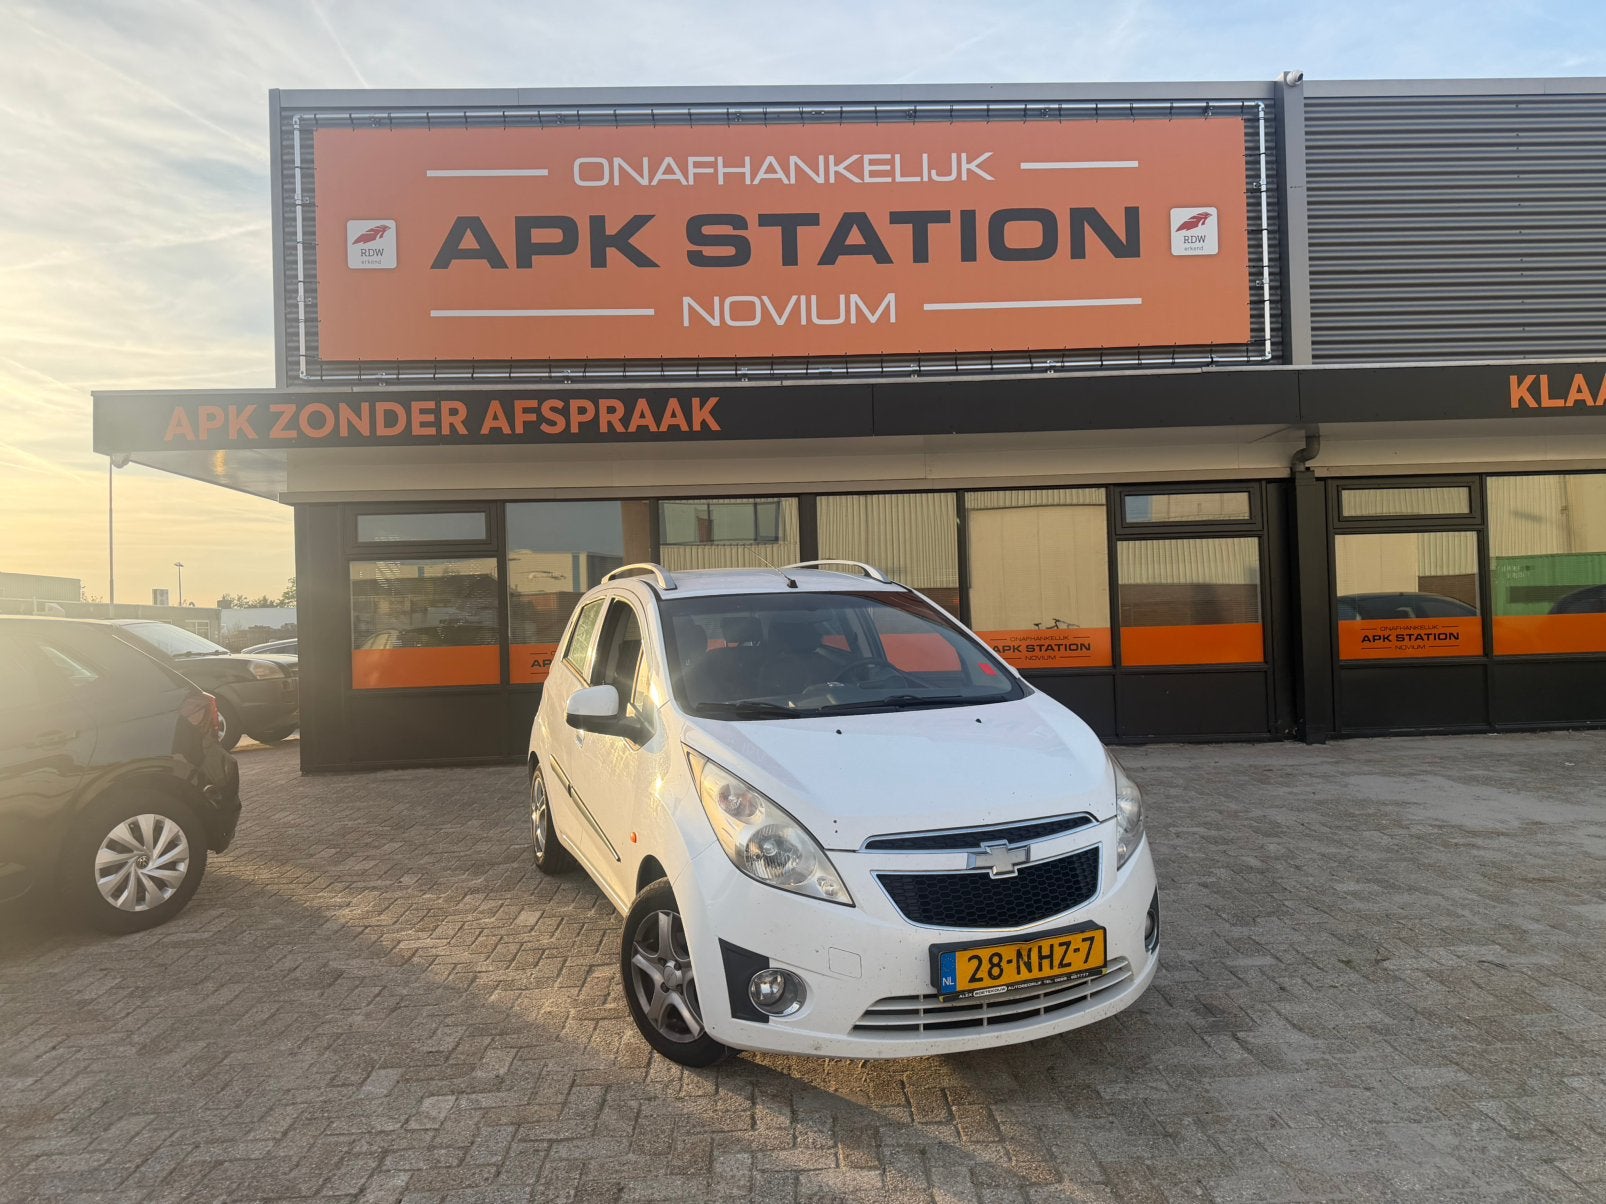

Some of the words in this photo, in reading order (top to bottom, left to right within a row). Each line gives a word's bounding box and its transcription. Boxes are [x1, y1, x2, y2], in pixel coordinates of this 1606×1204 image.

[573, 152, 996, 187] ONAFHANKELIJK
[430, 214, 661, 270] APK
[685, 206, 1141, 268] STATION
[1183, 235, 1206, 244] RDW
[360, 248, 384, 257] RDW
[682, 292, 896, 327] NOVIUM
[164, 404, 259, 442] APK
[269, 399, 469, 439] ZONDER
[480, 396, 722, 435] AFSPRAAK
[1361, 634, 1392, 643] APK
[1395, 632, 1460, 642] STATION
[993, 645, 1022, 654] APK
[1025, 643, 1091, 653] STATION
[531, 659, 552, 667] AP
[967, 936, 1096, 984] 28-NHZ-7
[942, 976, 955, 986] NL
